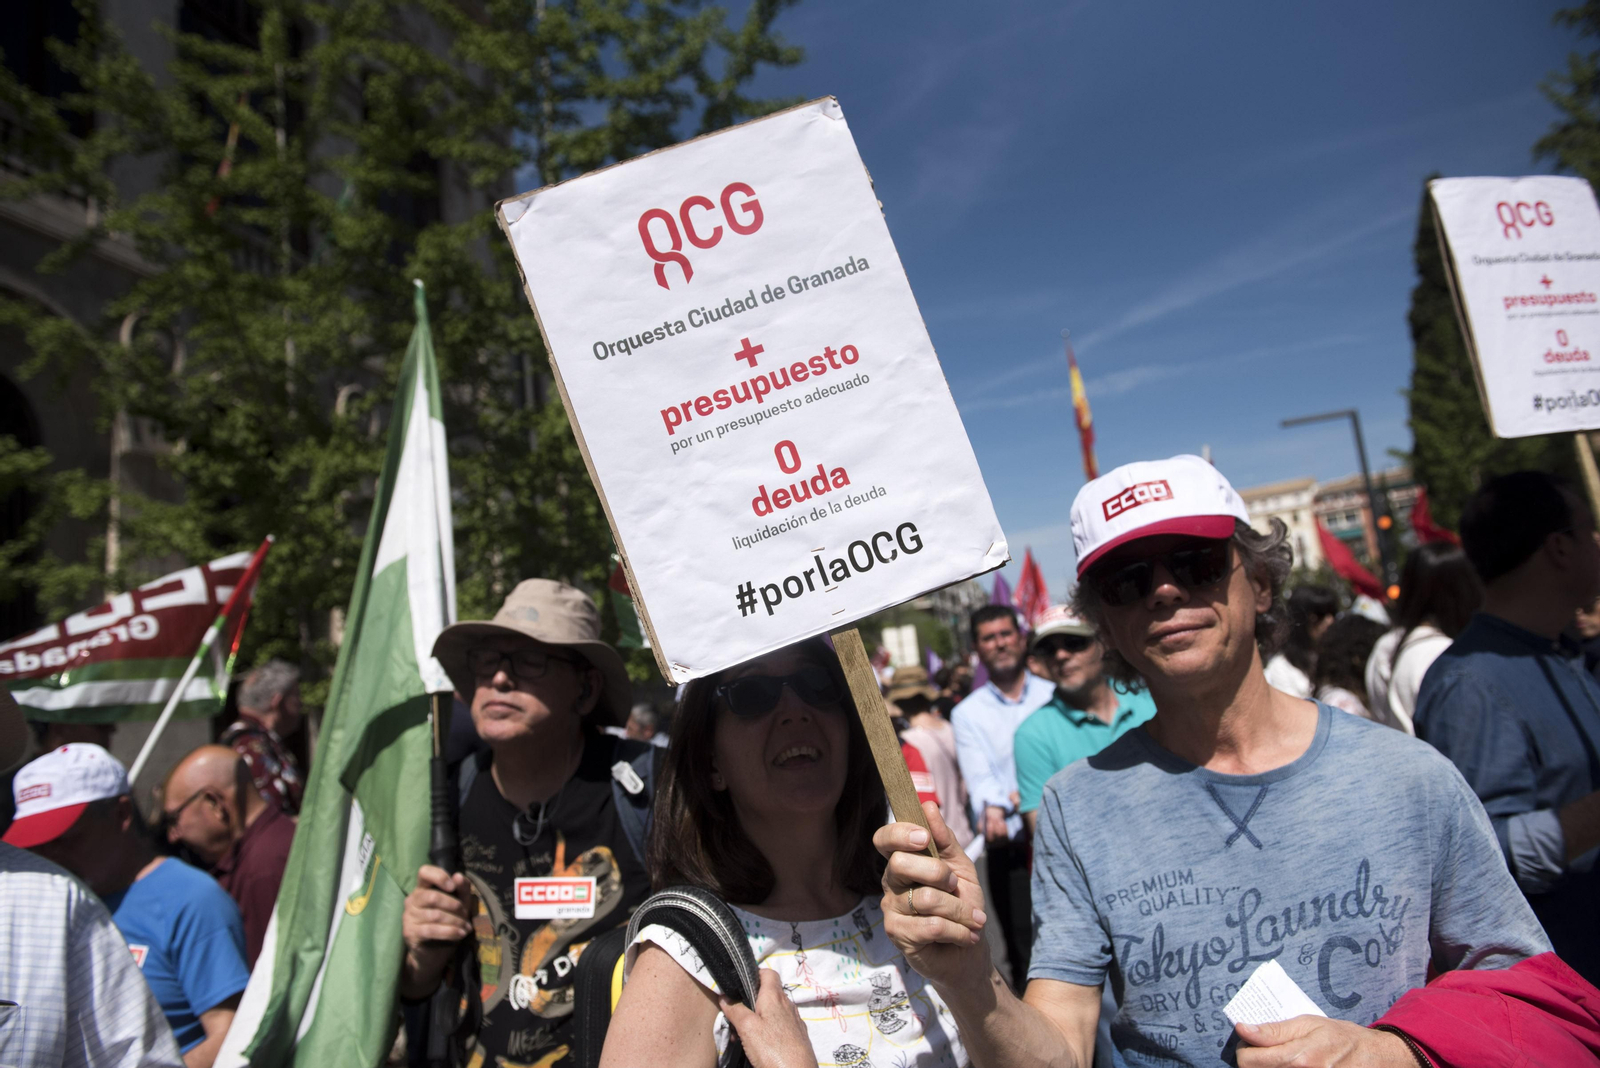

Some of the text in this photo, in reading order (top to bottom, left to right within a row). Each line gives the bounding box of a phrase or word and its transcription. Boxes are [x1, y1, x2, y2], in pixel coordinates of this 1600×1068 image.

[592, 256, 870, 360] Orquesta Ciudad de Granada
[1503, 291, 1597, 310] presupuesto
[734, 337, 765, 368] +
[1544, 348, 1590, 364] deuda
[660, 344, 860, 436] presupuesto
[1534, 388, 1600, 413] #porlaO
[670, 373, 871, 455] por un presupuesto adecuado
[751, 464, 851, 517] deuda
[1106, 483, 1169, 516] CCOO
[731, 485, 887, 550] liquidación de la deuda
[735, 521, 924, 618] #porlaOCG
[520, 885, 574, 902] CCOO
[557, 906, 590, 914] granada
[1111, 922, 1235, 1009] Tokyo
[1225, 857, 1411, 973] Laundry
[1140, 991, 1181, 1012] DRY
[1194, 1013, 1208, 1033] &
